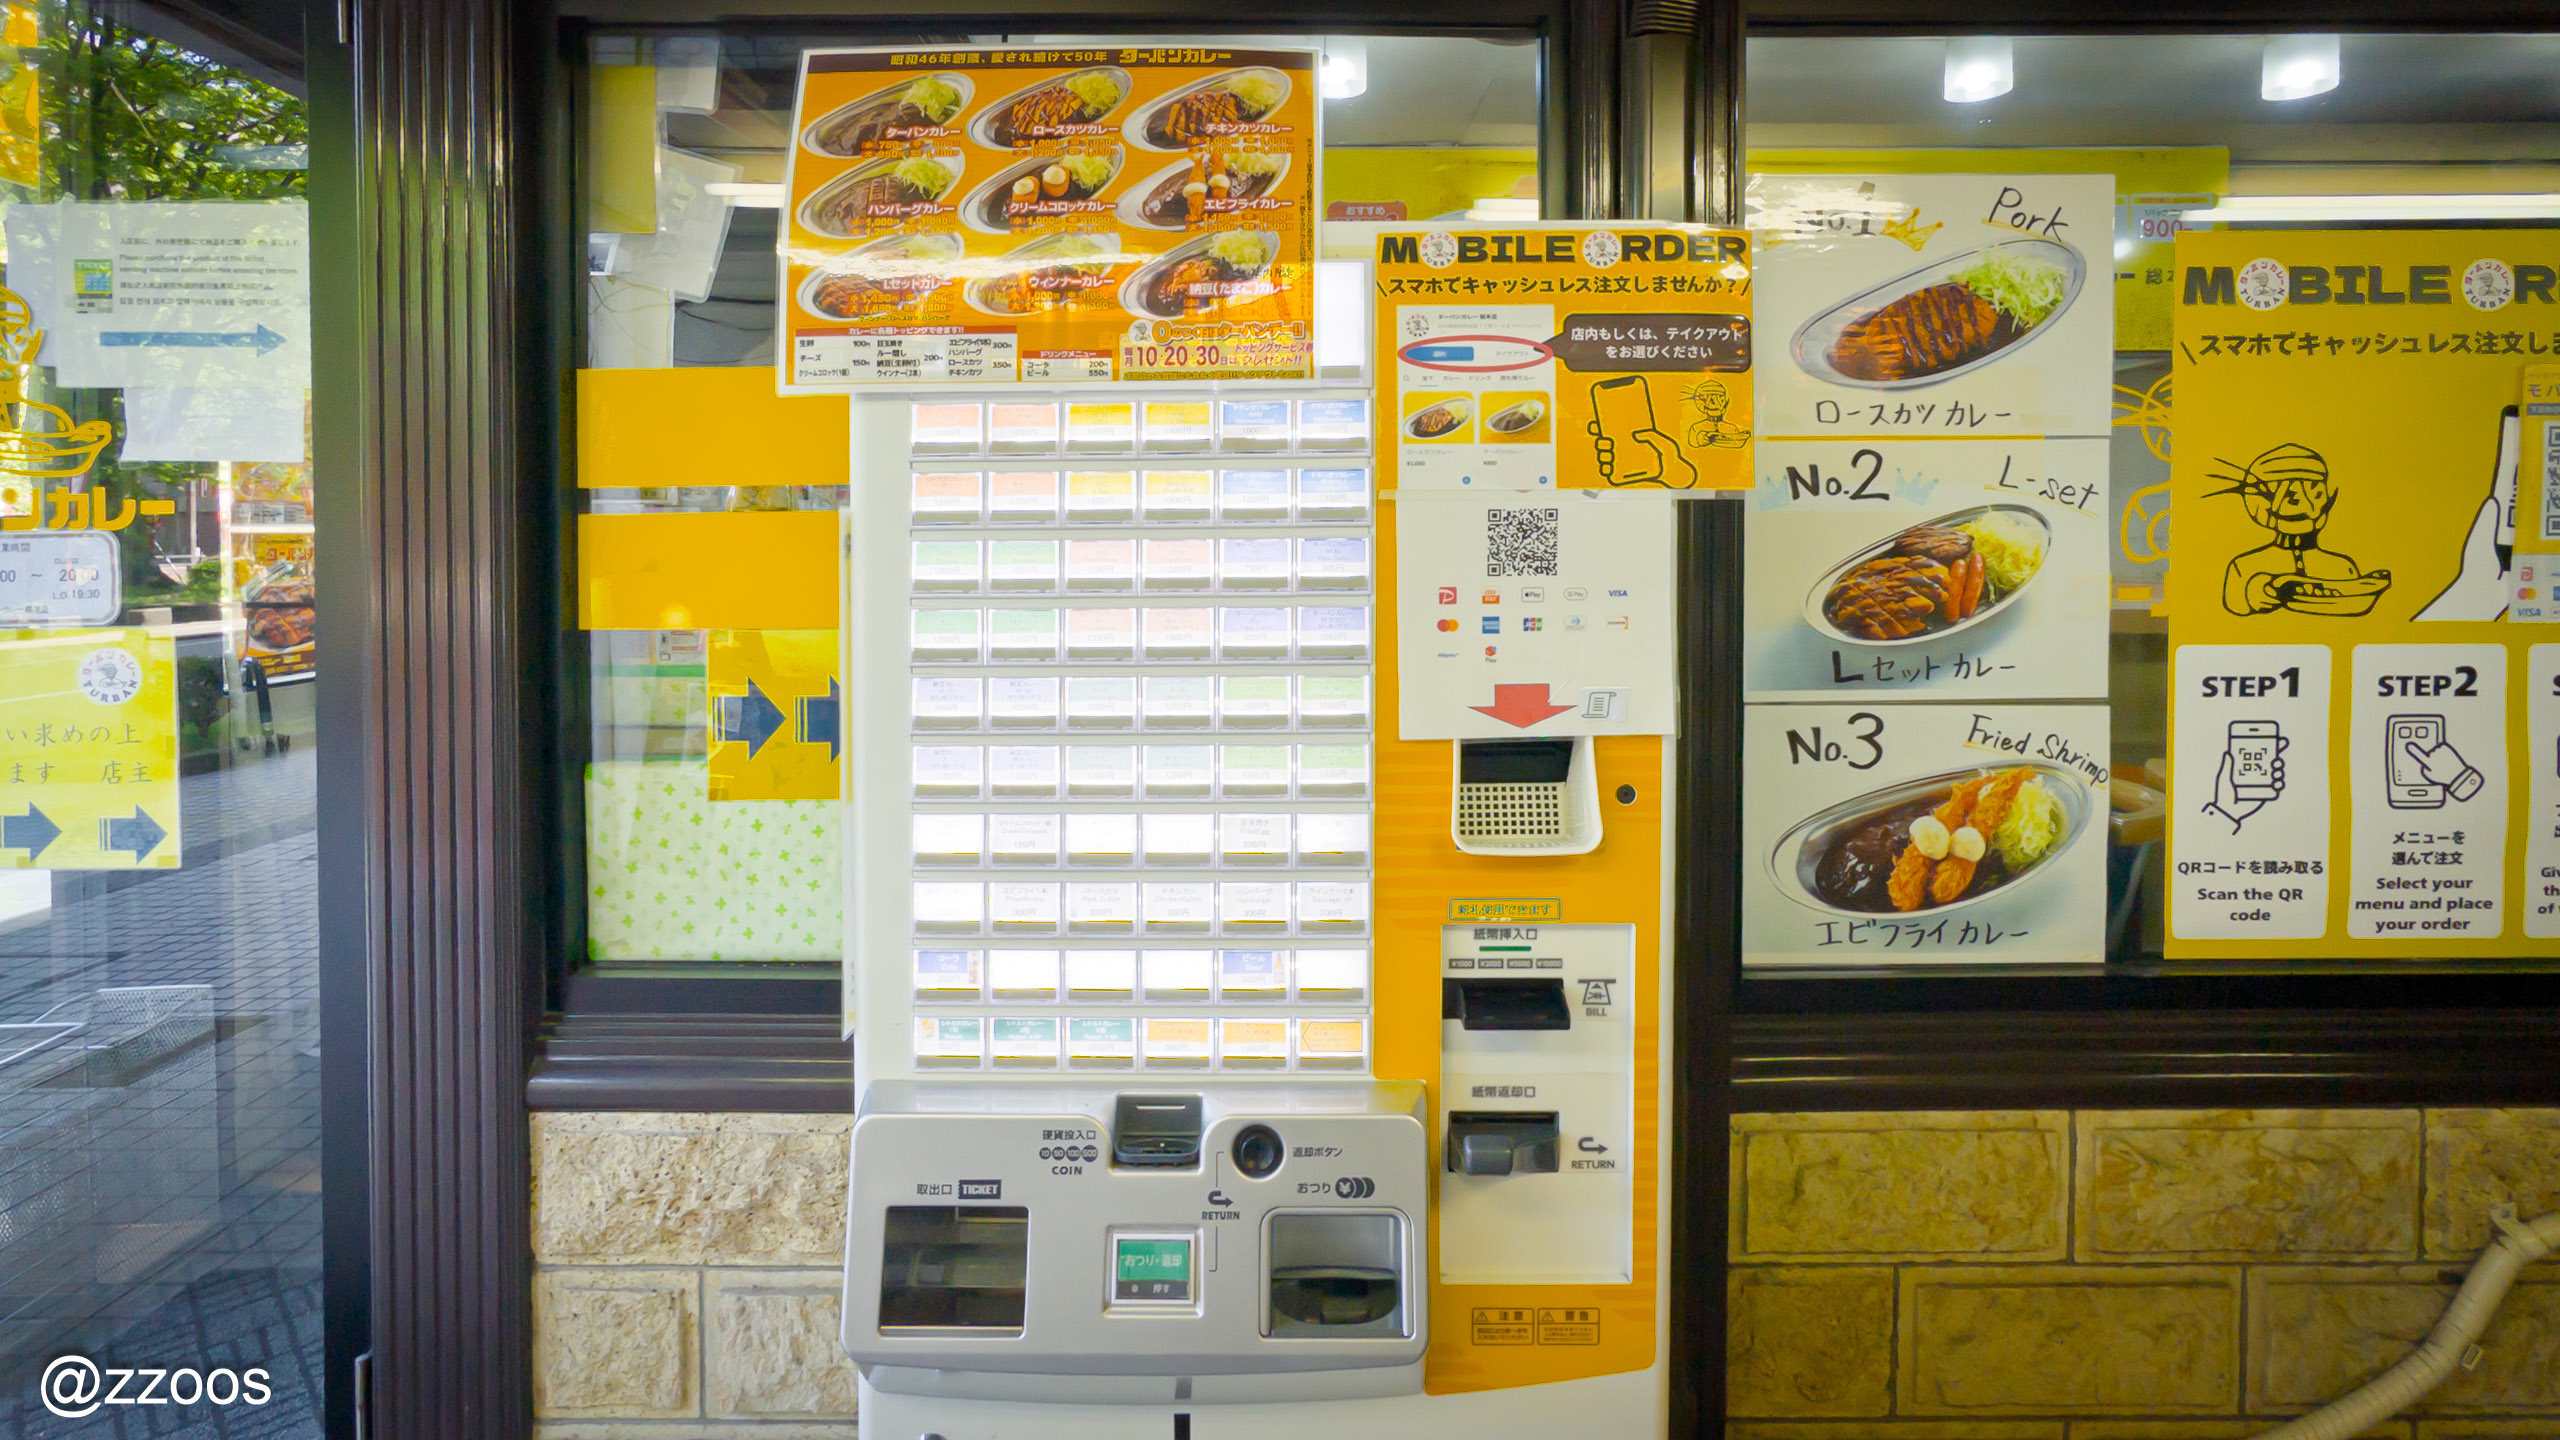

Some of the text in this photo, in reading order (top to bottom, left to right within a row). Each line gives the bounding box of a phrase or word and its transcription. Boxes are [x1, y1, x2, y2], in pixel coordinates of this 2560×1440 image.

[1118, 48, 1232, 64] ターバンカレー
[886, 126, 961, 139] ターバンカレー
[1032, 124, 1119, 136] ロースカツカレー
[1204, 122, 1292, 135] チキンカツカレー
[867, 202, 955, 216] ハンバーグカレー
[1009, 200, 1117, 213] クリームコロッケカレー
[1203, 198, 1293, 210] エビフライカレー
[1345, 205, 1386, 216] おすすめ
[1988, 186, 2070, 243] Pork
[882, 278, 953, 290] Lセットカレー
[1028, 275, 1115, 288] ウィンナーカレー
[799, 354, 822, 362] チーズ
[948, 348, 984, 357] ハンバーグ
[1039, 350, 1097, 359] ドリンクメニュー
[1605, 345, 1713, 359] をお選びください
[948, 358, 983, 367] ロースカツ
[1027, 361, 1050, 370] コーラ
[948, 368, 983, 376] チキンカツ
[1027, 369, 1050, 378] ビール
[71, 589, 100, 600] 19:30
[1608, 589, 1629, 598] VISA
[2516, 608, 2541, 617] VISA
[1966, 713, 2109, 787] Fried Shrimp
[9, 759, 153, 785] ます 店主
[2392, 831, 2466, 846] メニューを
[2391, 851, 2464, 866] 選んで注文
[2177, 860, 2324, 876] QRコードを読み取る
[2376, 877, 2473, 892] Select your
[2197, 887, 2304, 901] Scan the QR
[2354, 897, 2493, 912] menu and place
[2229, 908, 2271, 921] code
[2375, 918, 2470, 934] your order
[1473, 927, 1538, 941] 紙幣挿入口
[1585, 1007, 1607, 1017] BILL
[1471, 1085, 1536, 1099] 紙幣返却口
[1042, 1129, 1097, 1141] 硬貨投入口
[1292, 1145, 1344, 1159] 返却ボタン
[1051, 1166, 1083, 1176] COIN
[1570, 1159, 1616, 1170] RETURN
[916, 1183, 1000, 1197] 取出口 TICKET
[1296, 1181, 1332, 1195] おつり
[1201, 1211, 1241, 1221] RETURN
